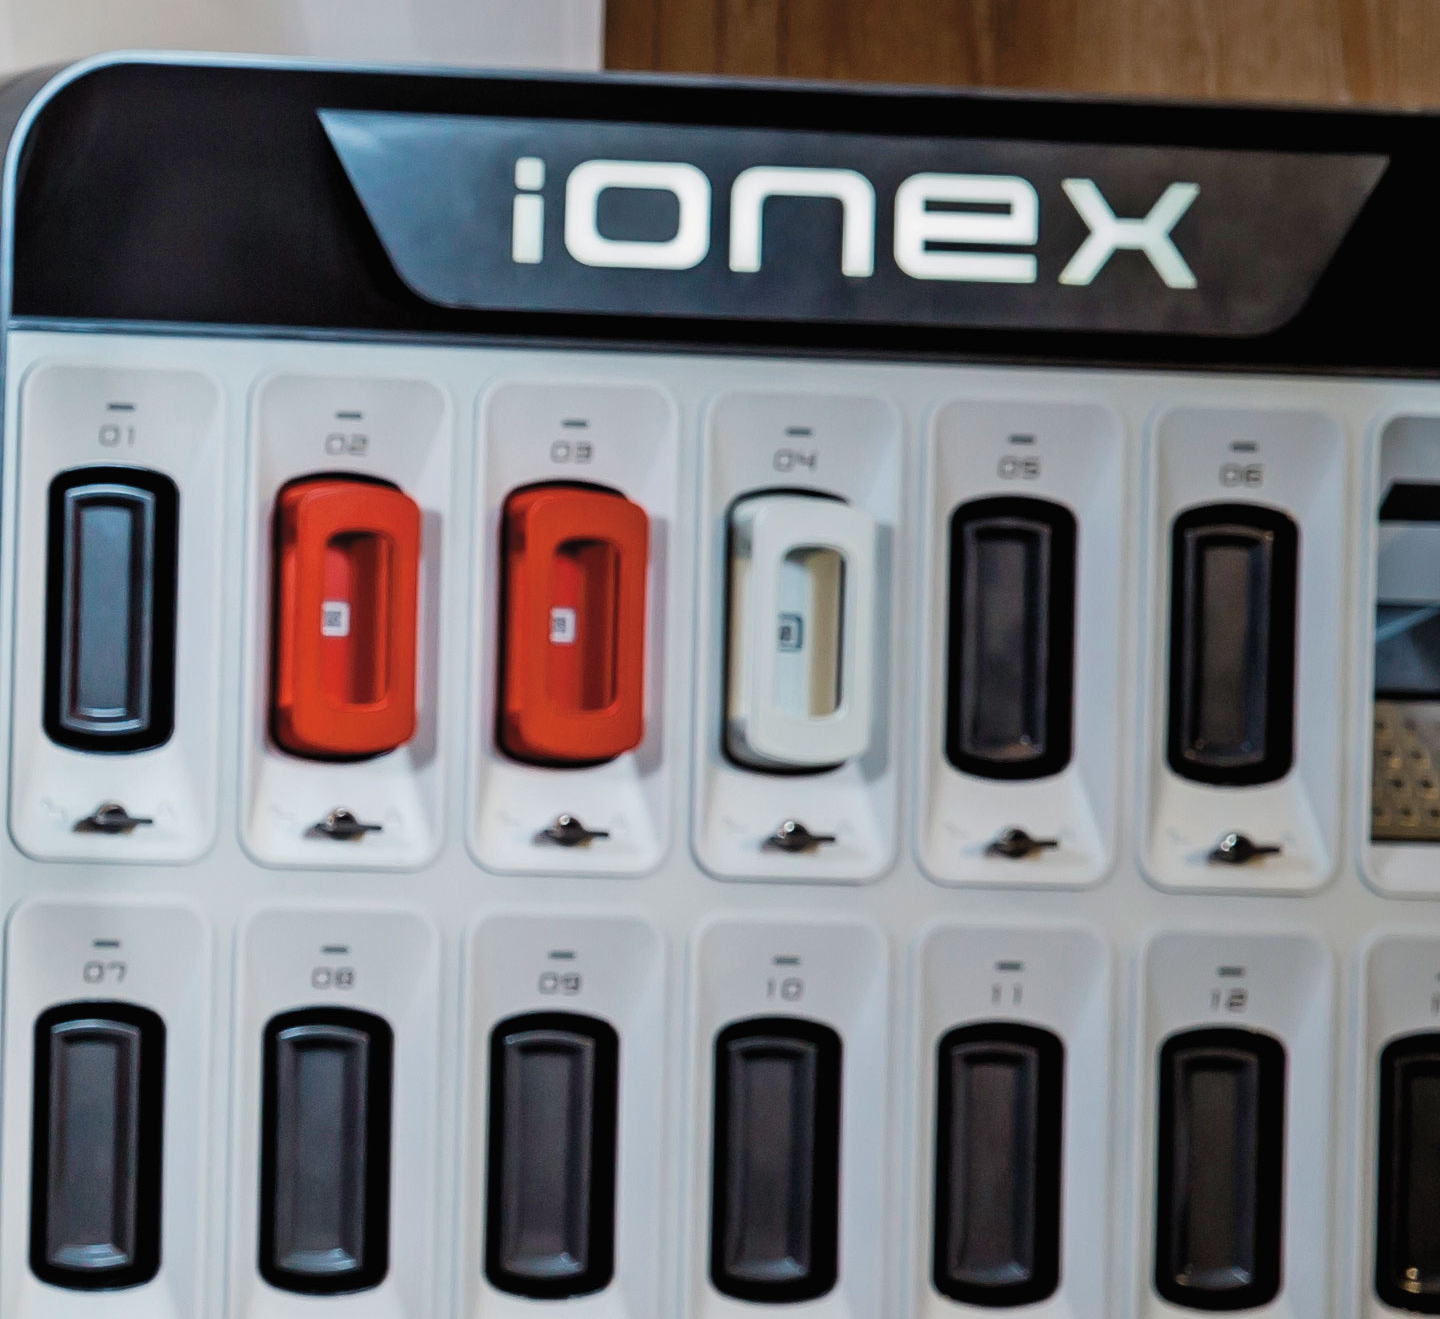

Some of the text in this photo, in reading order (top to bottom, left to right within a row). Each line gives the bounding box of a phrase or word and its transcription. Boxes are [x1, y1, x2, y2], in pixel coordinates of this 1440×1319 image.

[512, 157, 1200, 289] ionex
[325, 433, 370, 457] 02
[550, 440, 594, 464] 03
[773, 448, 818, 472] 04
[997, 455, 1041, 480] 05
[82, 959, 128, 984] 07
